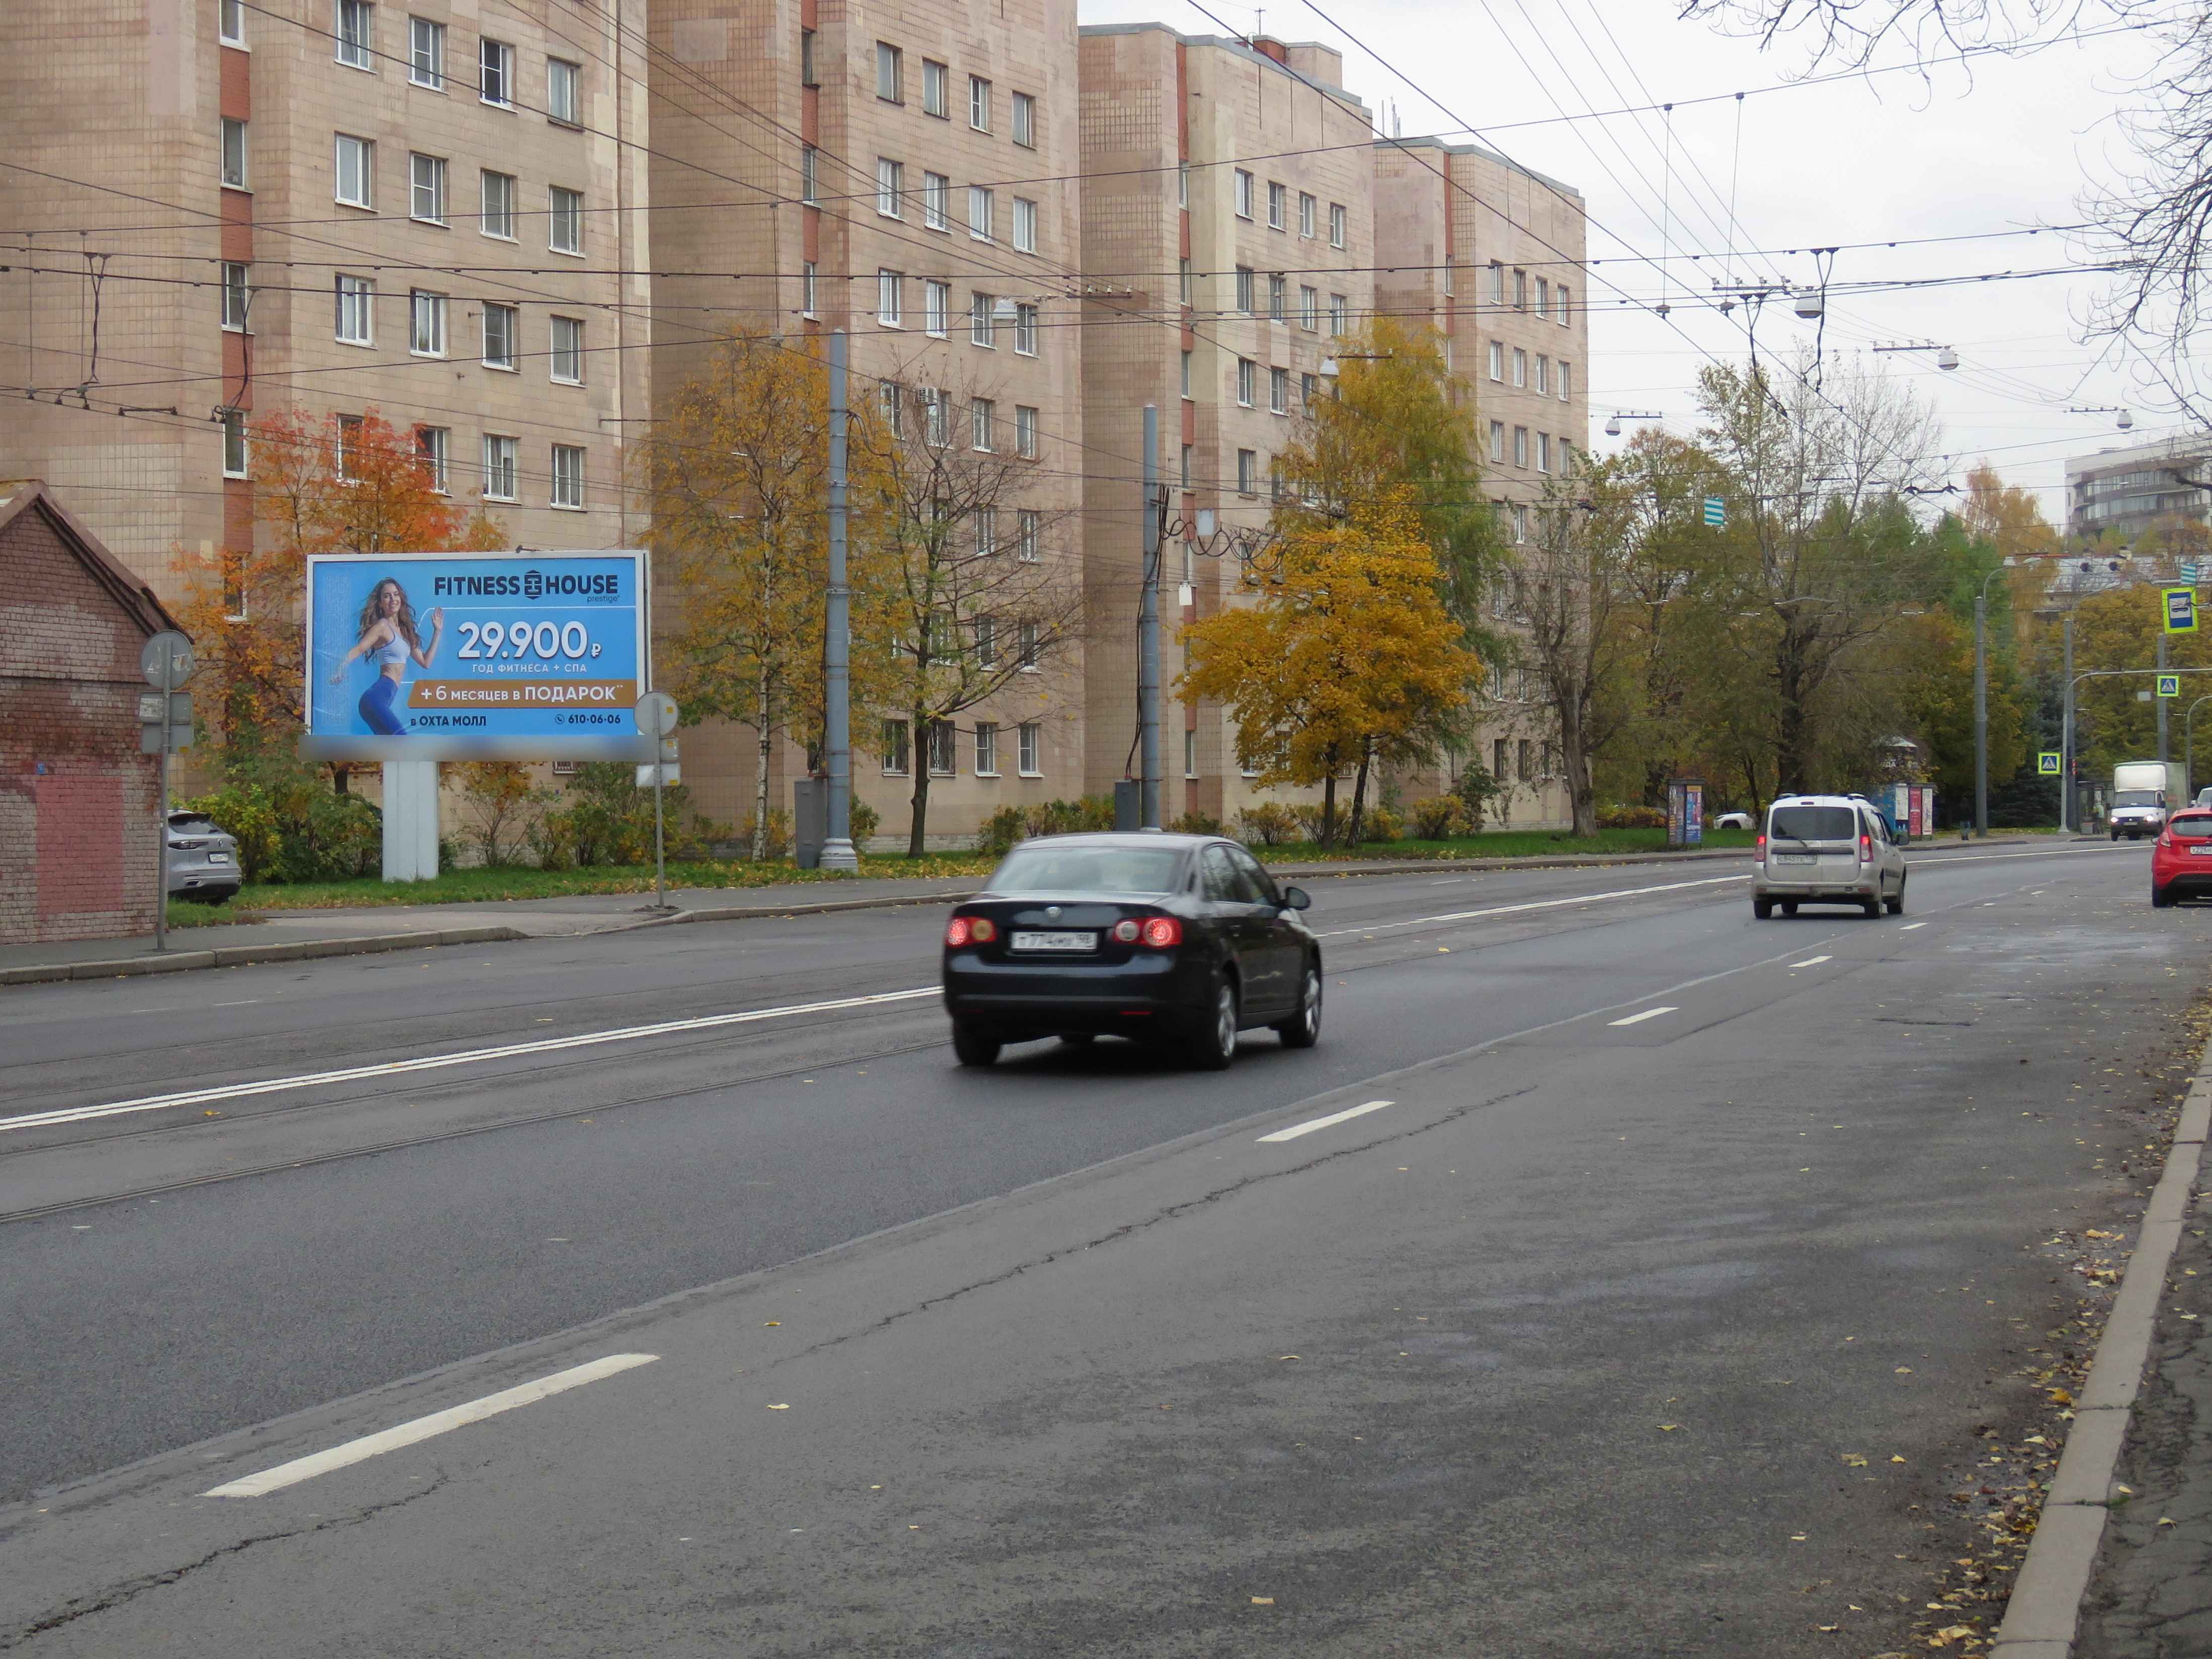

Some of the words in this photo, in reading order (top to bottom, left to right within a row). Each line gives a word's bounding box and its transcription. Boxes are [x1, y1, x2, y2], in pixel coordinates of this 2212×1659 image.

[434, 576, 520, 596] FITNESS
[546, 575, 618, 594] HOUSE
[458, 620, 588, 659] 29.900
[472, 664, 494, 673] ГОД
[498, 663, 549, 673] ФИТНЕСА
[564, 664, 587, 673] СПА
[525, 685, 616, 703] ПОДАРОК
[419, 716, 449, 726] ОХТА
[453, 716, 487, 726] МОЛЛ
